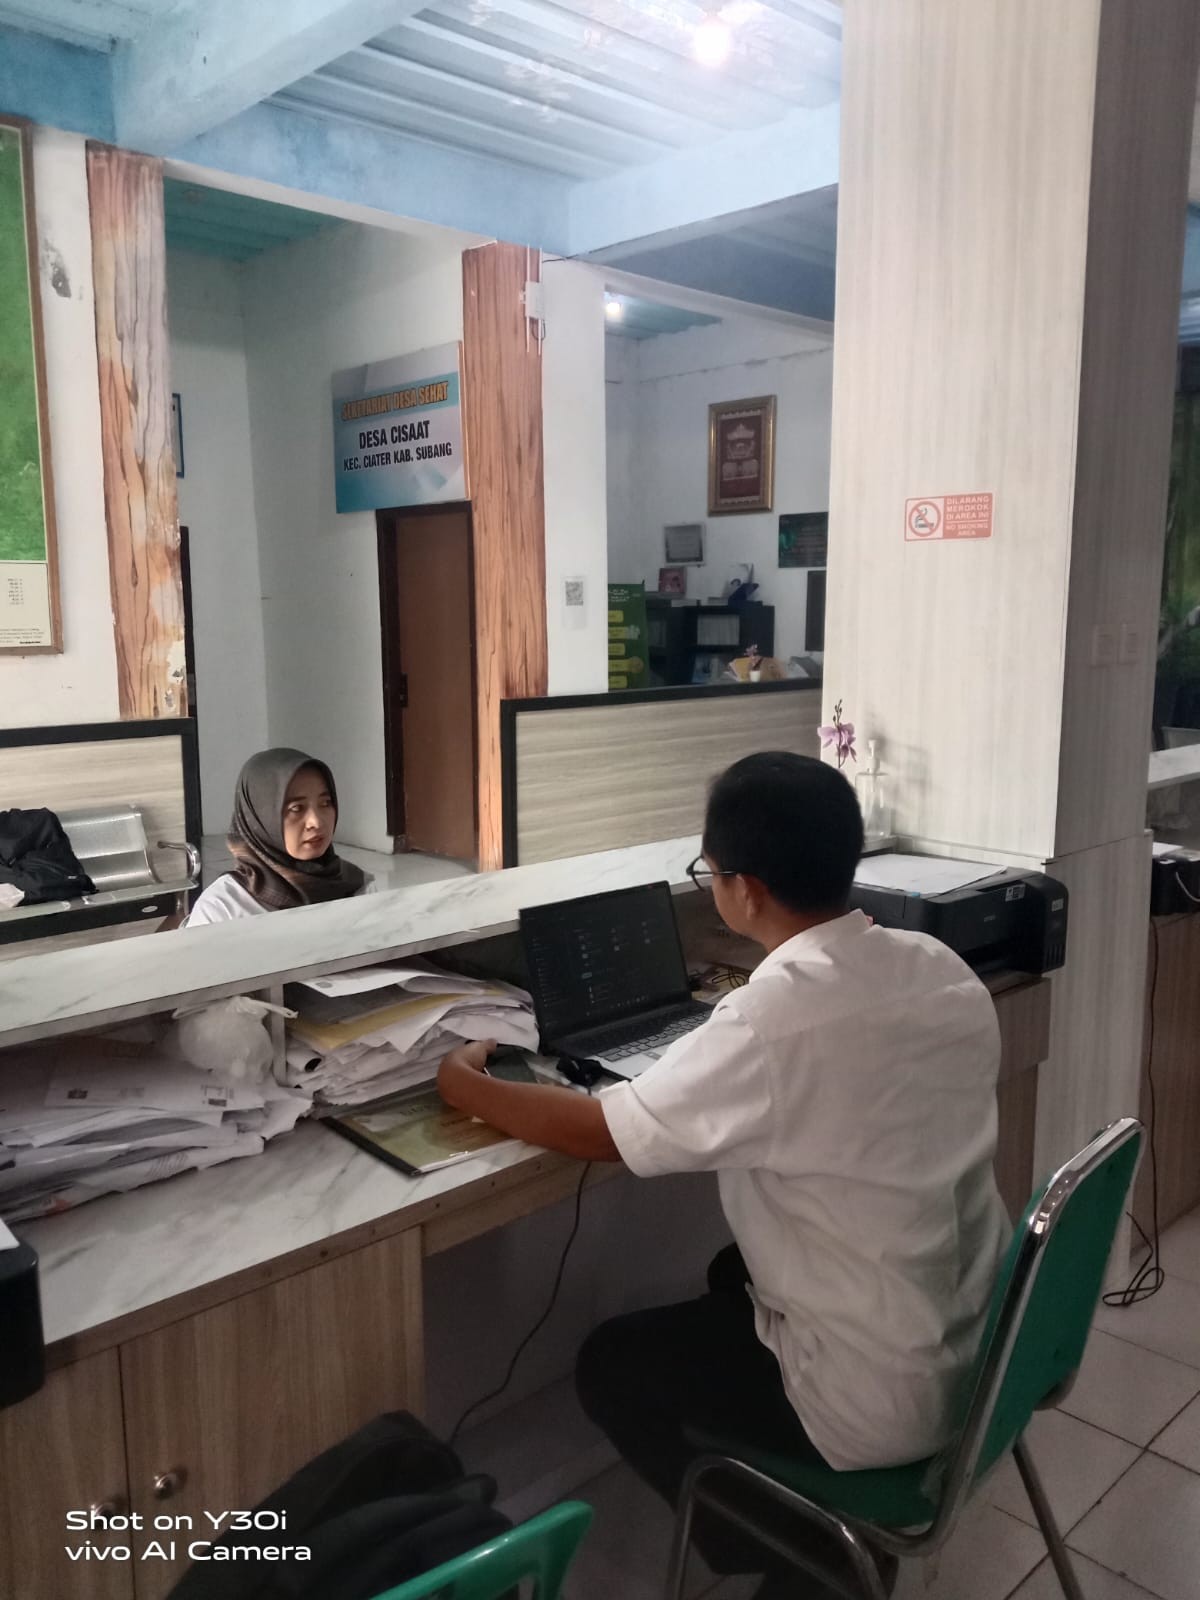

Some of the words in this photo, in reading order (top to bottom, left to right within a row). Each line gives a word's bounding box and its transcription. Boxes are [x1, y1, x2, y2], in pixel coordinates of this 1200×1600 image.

[393, 388, 417, 411] DESA
[418, 381, 449, 405] SEHAT
[359, 428, 388, 449] DESA
[390, 420, 430, 444] CISAAT
[343, 457, 362, 471] KEC.
[363, 451, 392, 468] CIATER
[393, 448, 414, 464] KAB.
[415, 442, 452, 461] SUBANG
[946, 496, 989, 505] DILARANG
[946, 504, 989, 512] MEROKOK
[946, 513, 954, 521] DI
[955, 512, 976, 520] AREA
